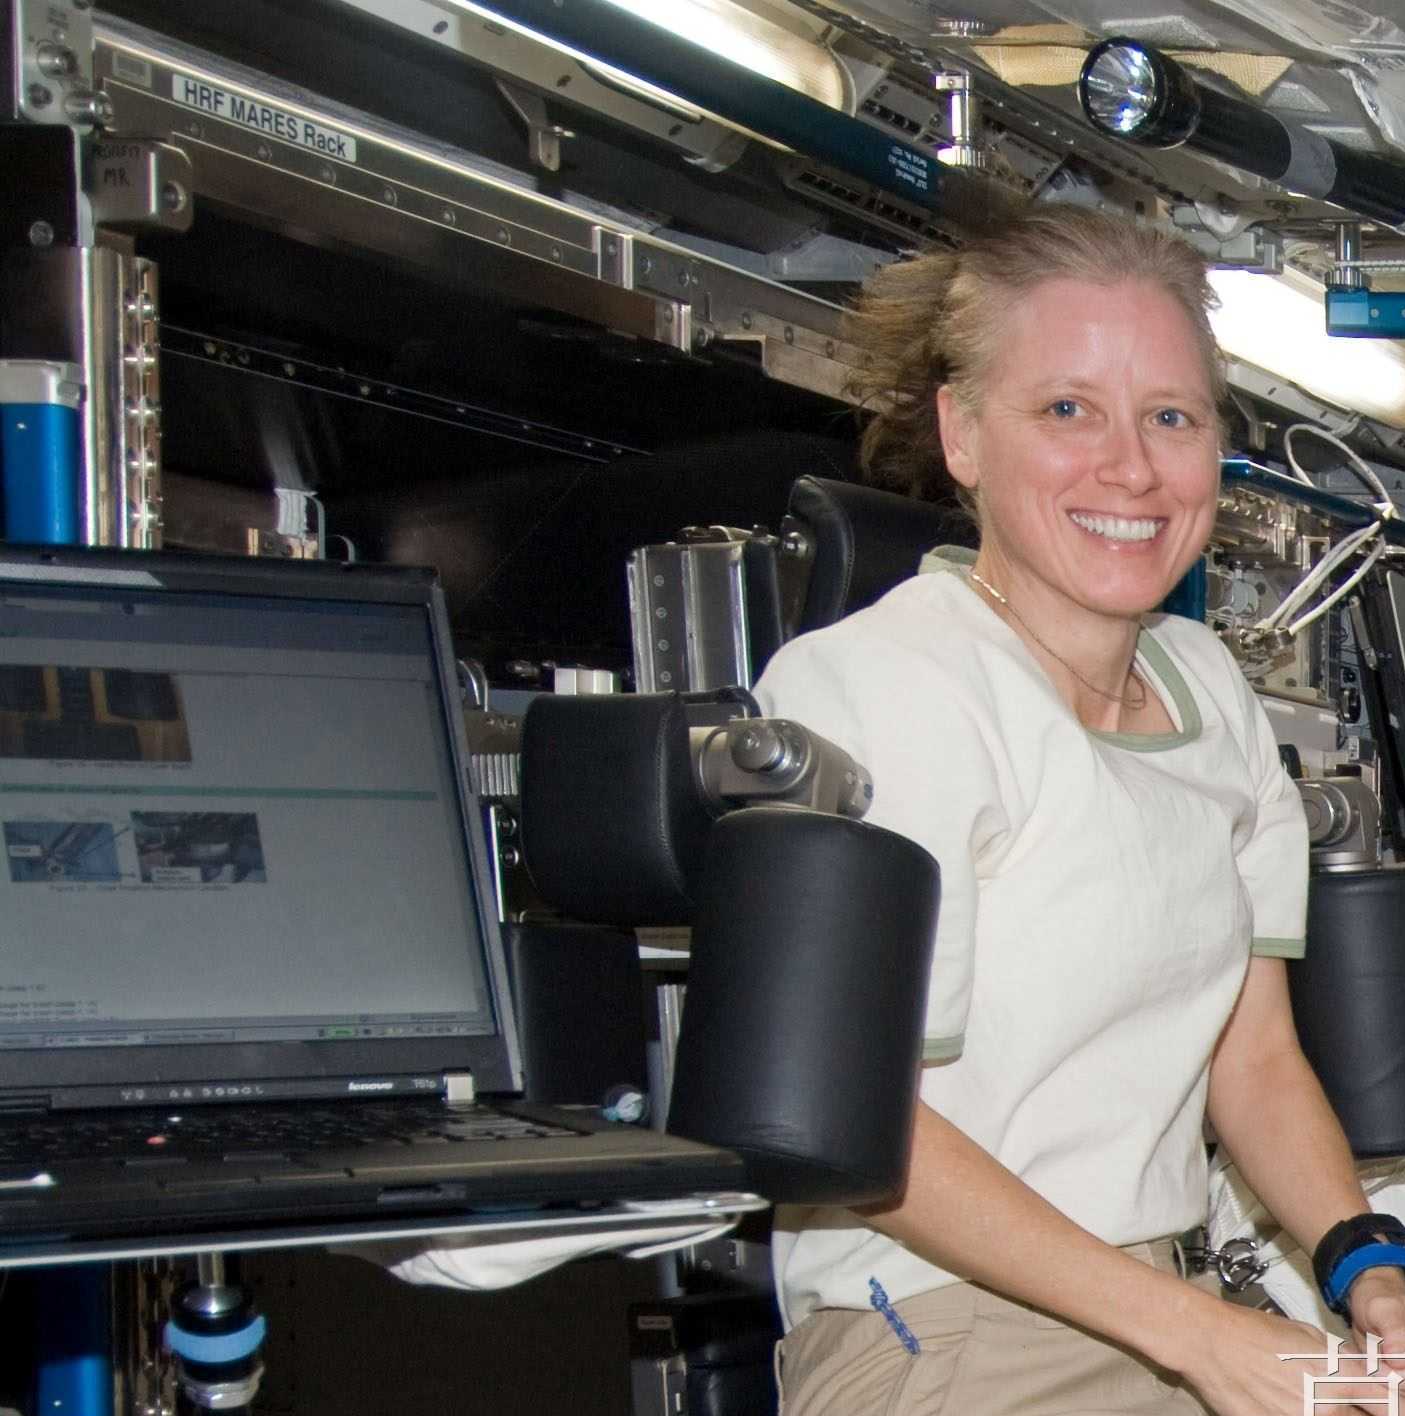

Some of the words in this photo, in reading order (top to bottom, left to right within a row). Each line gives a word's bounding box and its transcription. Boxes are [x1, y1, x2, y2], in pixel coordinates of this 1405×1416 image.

[183, 79, 224, 112] HRF
[230, 97, 298, 140] MARES
[304, 124, 347, 158] Rack
[348, 1081, 394, 1091] lenovo
